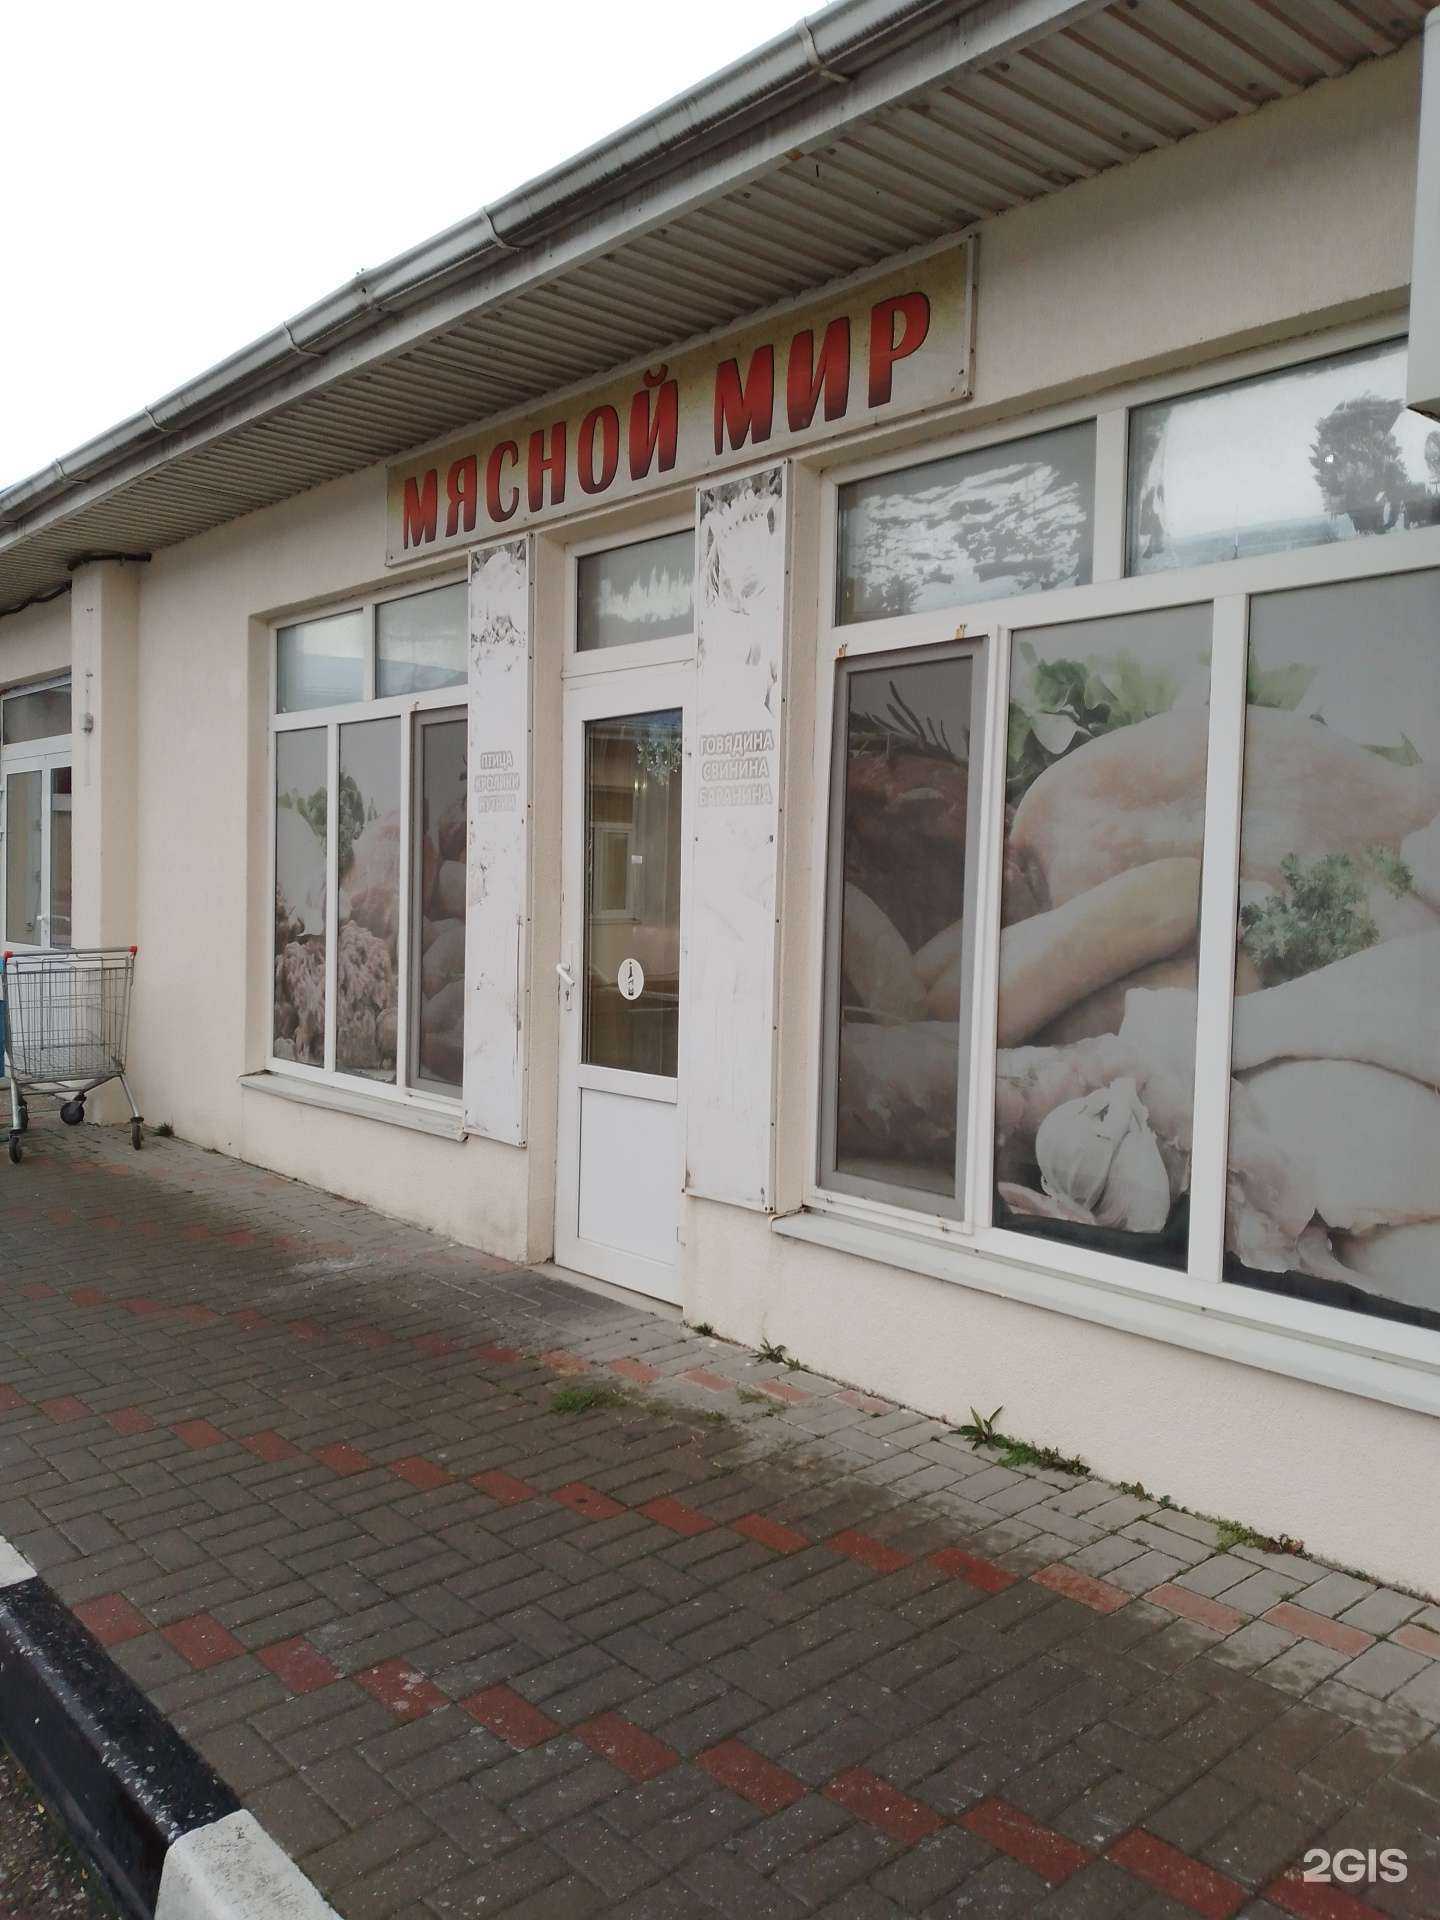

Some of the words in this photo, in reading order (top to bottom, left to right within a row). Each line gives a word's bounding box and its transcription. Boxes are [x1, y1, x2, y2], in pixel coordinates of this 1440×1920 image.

[403, 364, 679, 550] МЯСНОЙ
[713, 292, 931, 456] МИР
[700, 730, 774, 756] ГОВЯДИНА
[702, 757, 769, 780] СВИНИНА
